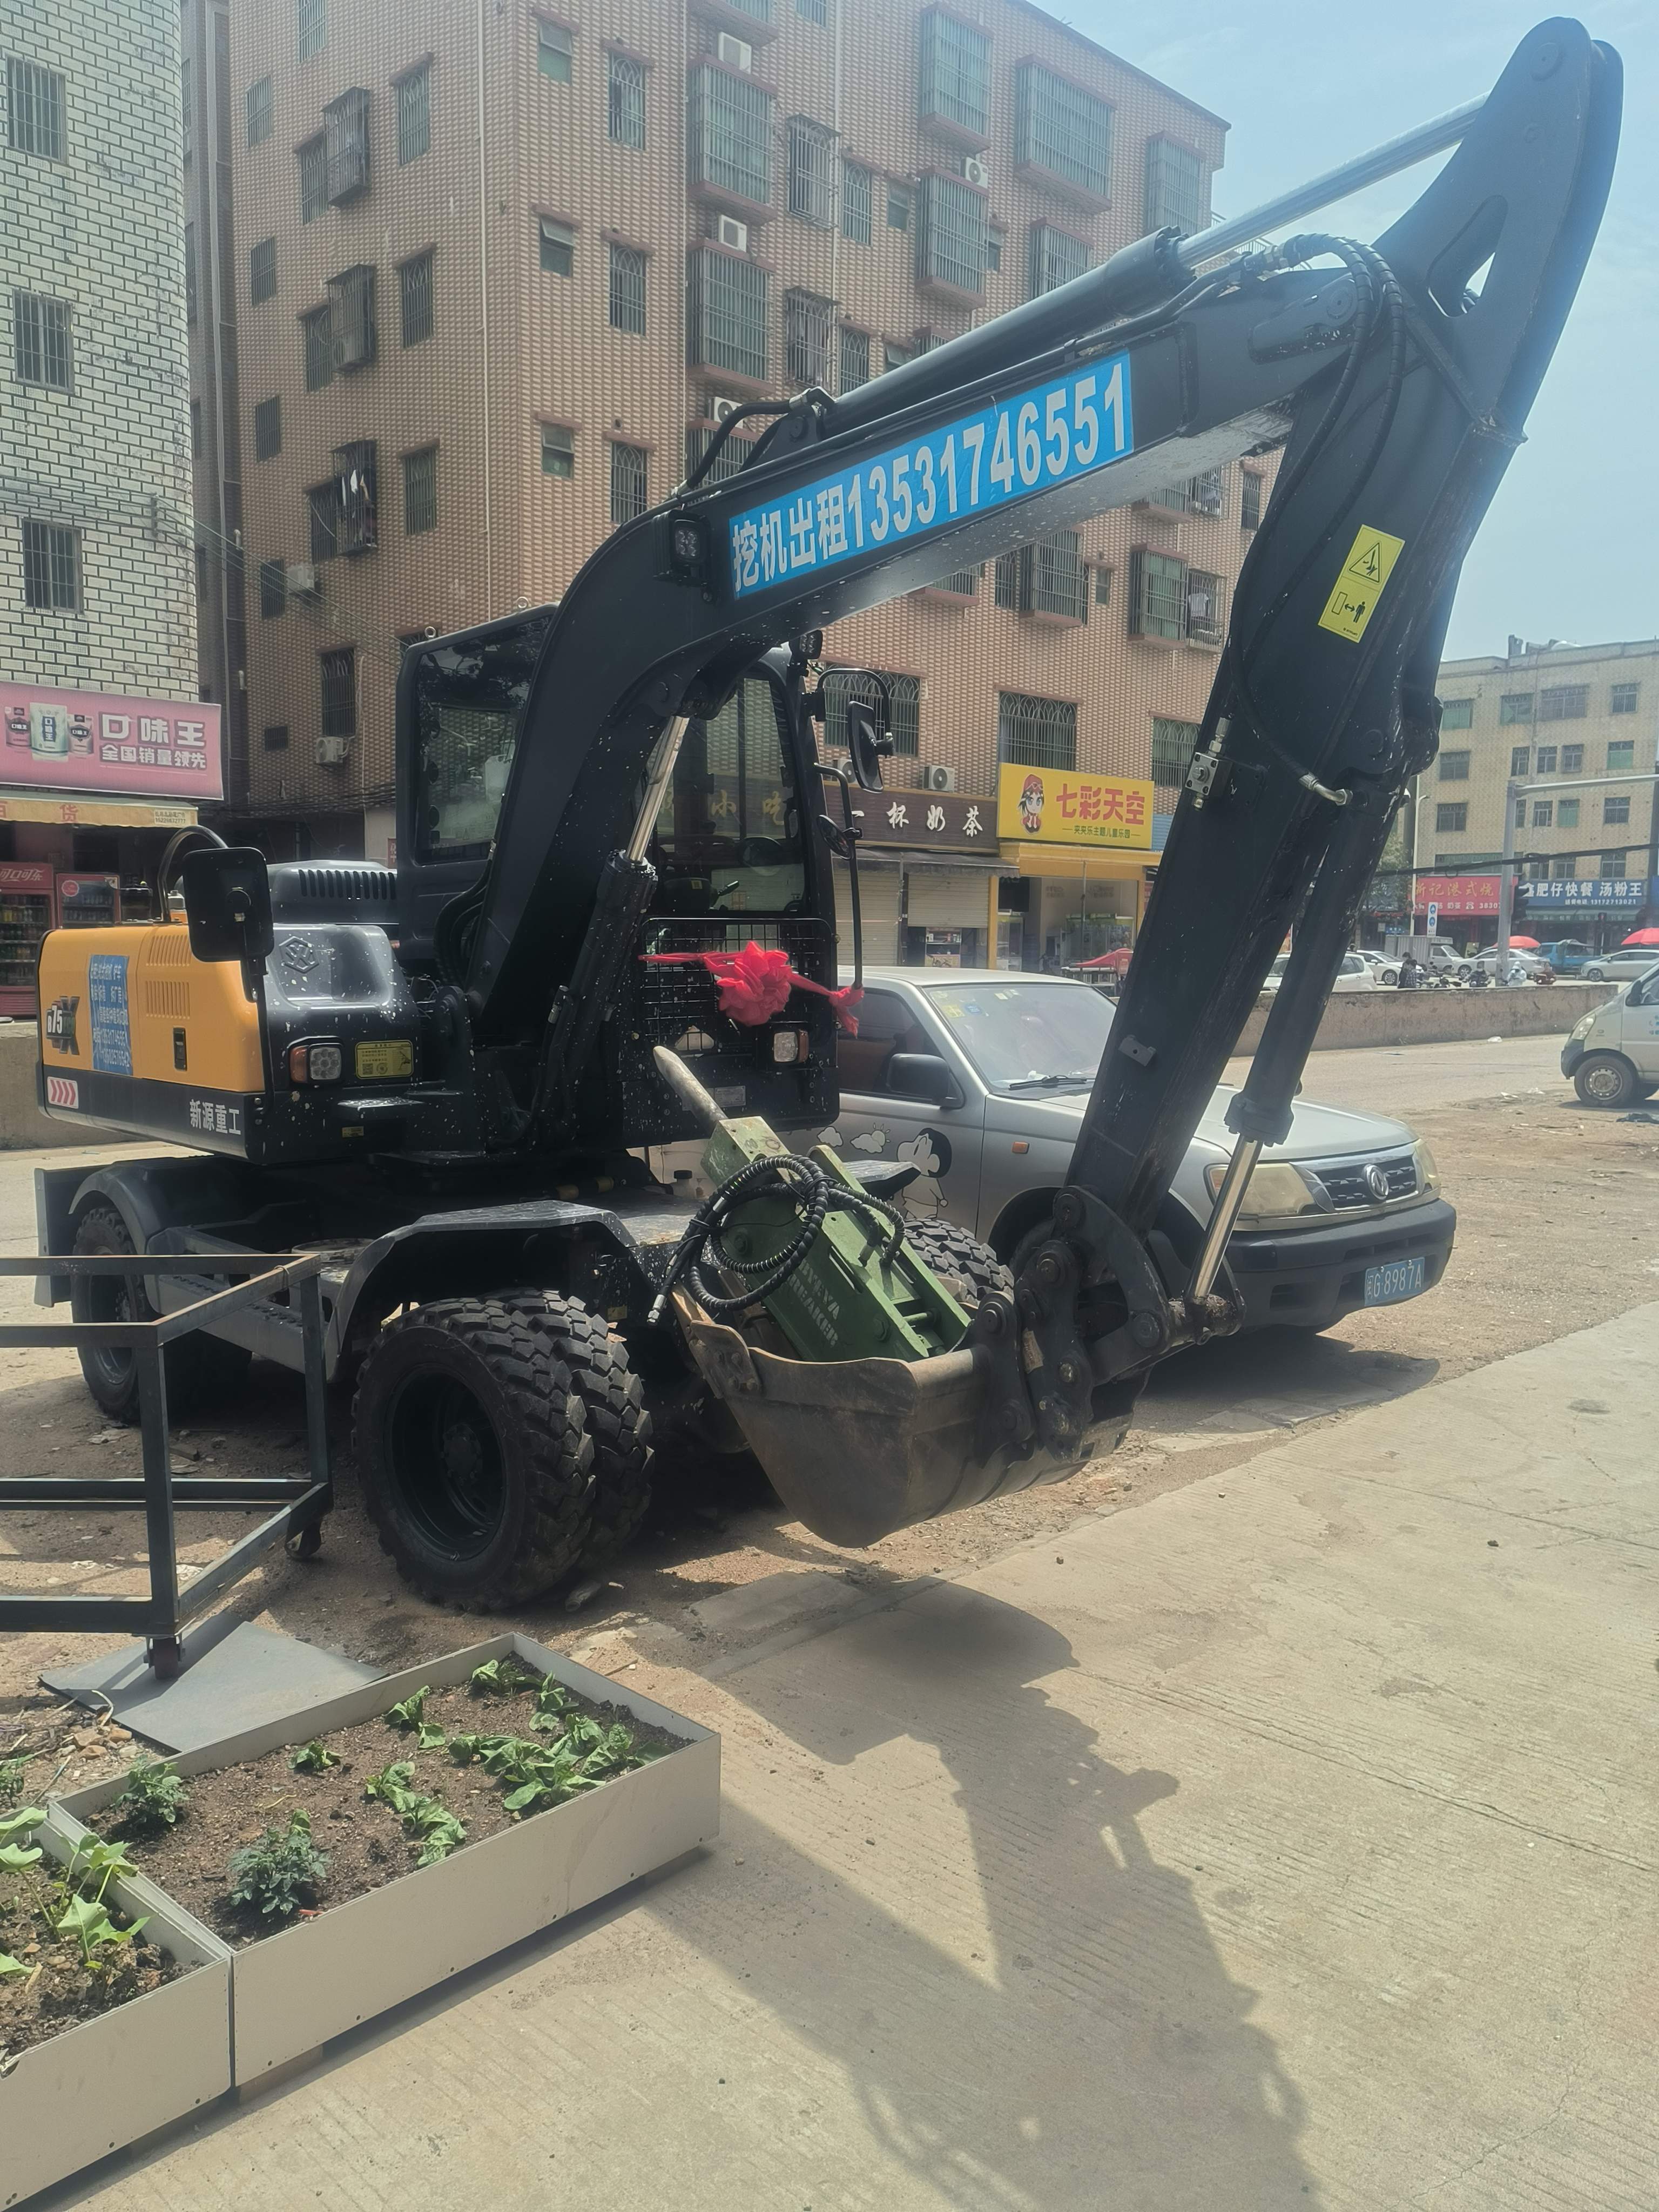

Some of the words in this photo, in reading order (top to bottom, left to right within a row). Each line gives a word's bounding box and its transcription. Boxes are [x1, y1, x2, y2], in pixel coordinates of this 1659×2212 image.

[732, 362, 1126, 591] 挖机出租13531746551
[102, 713, 205, 746] 口味王
[102, 744, 206, 768] 全国销量领先
[1056, 783, 1145, 825] 七彩天空
[1599, 882, 1642, 896] 汤粉王
[190, 1098, 241, 1135] 新源重工
[786, 1273, 838, 1347] REAKER
